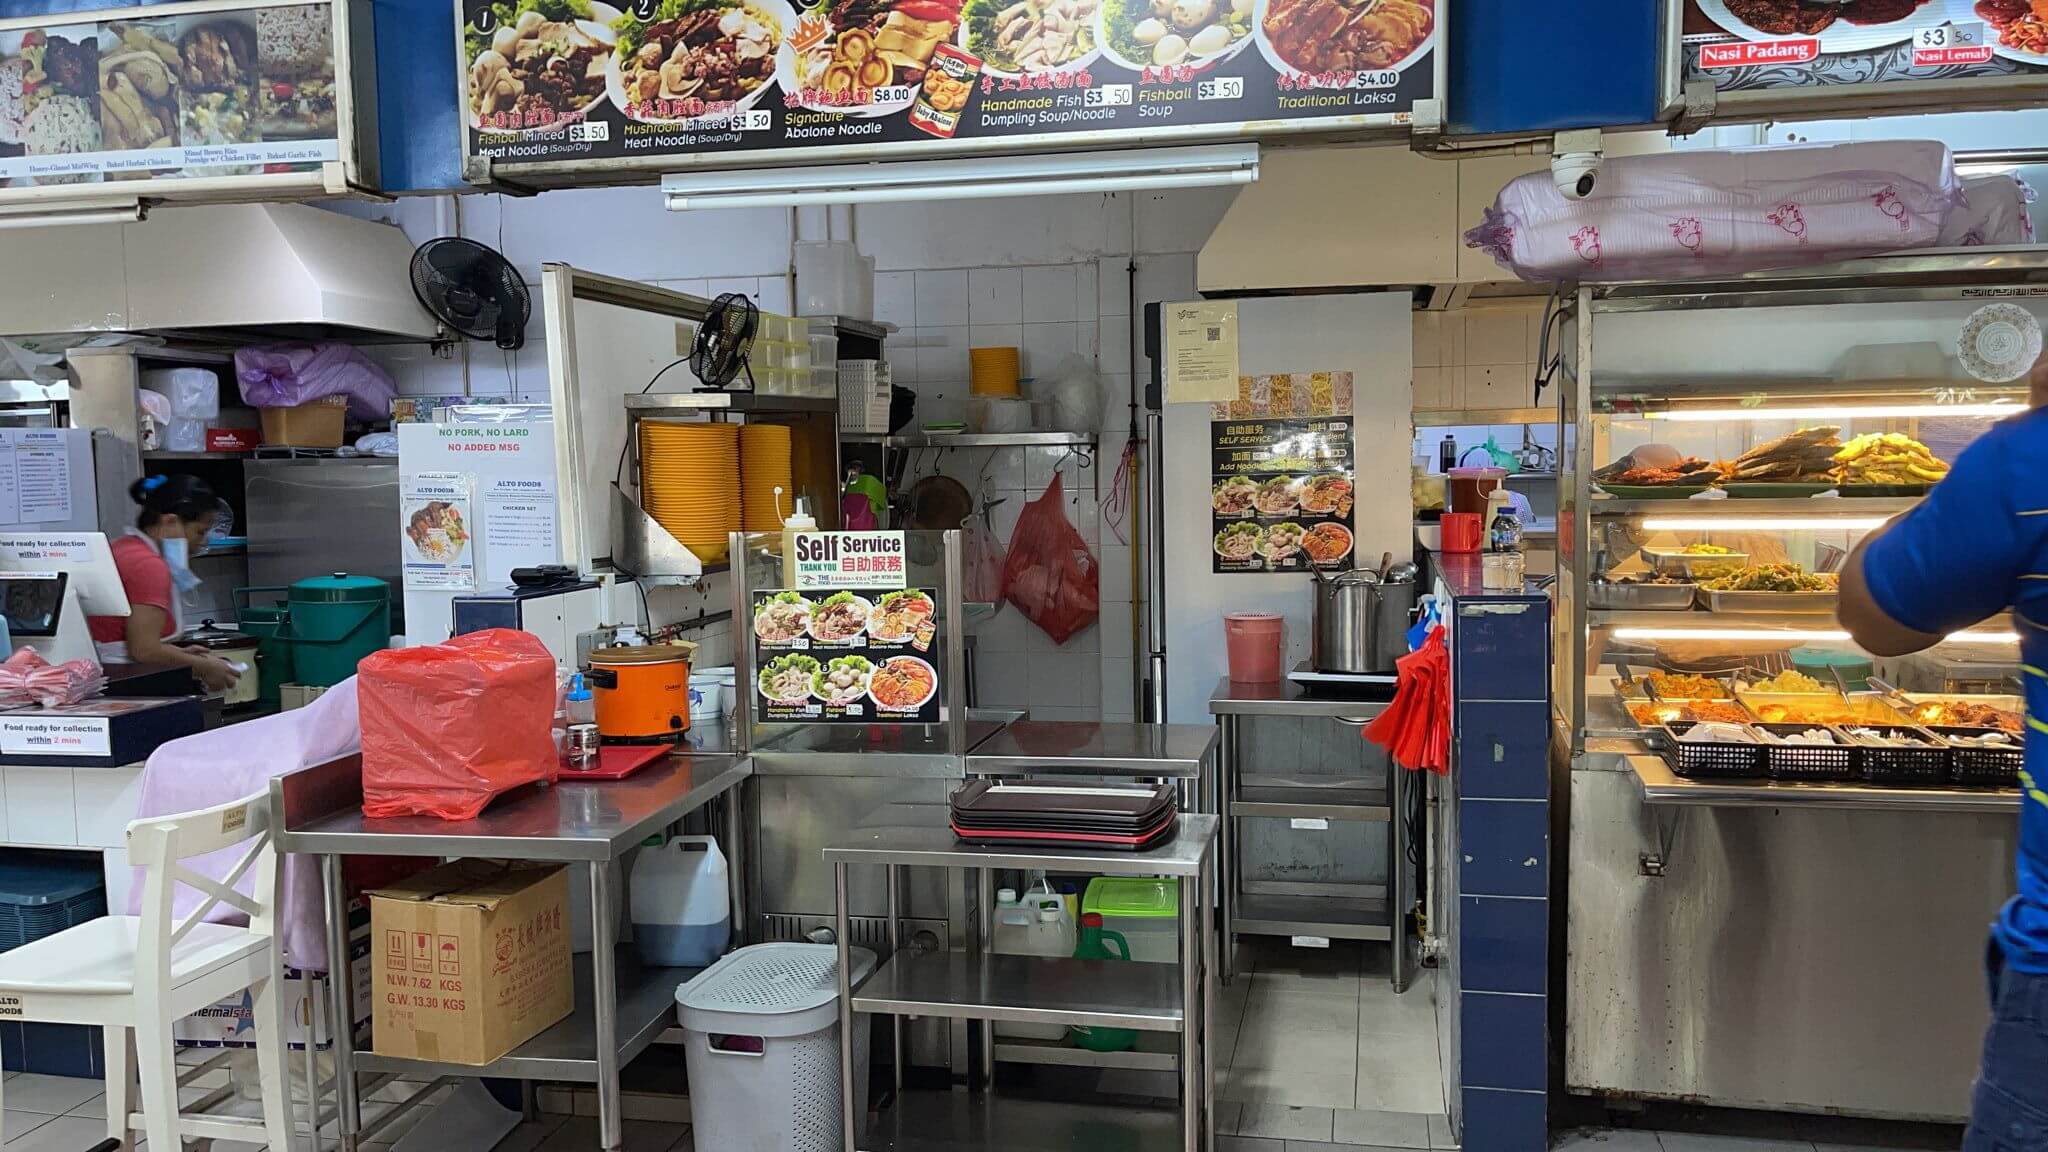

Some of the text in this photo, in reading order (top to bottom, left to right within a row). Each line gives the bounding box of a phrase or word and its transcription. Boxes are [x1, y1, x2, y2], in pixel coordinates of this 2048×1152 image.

[482, 11, 488, 27] 1
[1923, 26, 1945, 46] $3
[1704, 43, 1808, 60] Nasi Padang
[1915, 48, 1988, 61] Nasi Lemak
[1358, 73, 1396, 86] $4.00
[874, 88, 909, 102] $8.00
[1139, 81, 1240, 101] Fishball $3.50
[981, 88, 1129, 111] Handmade Fish $3.50
[1277, 92, 1396, 108] Traditional Laksa
[785, 111, 843, 125] Signature
[981, 108, 1116, 127] Dumpling Soup/Noodle
[1139, 104, 1173, 117] Soup
[624, 114, 769, 135] Mushroom Minced $3.50
[785, 123, 882, 139] Abalone Noodle
[479, 126, 606, 145] Fishball Minced $3.50
[624, 132, 742, 149] Meat Noodle (Soup/Dry)
[479, 143, 592, 158] Meat Noodle (Soup/Dry)
[439, 428, 529, 438] NO PORK, NO LARD
[1241, 435, 1272, 443] SERVICE
[448, 443, 520, 451] NO ADDED MSG
[796, 535, 900, 561] Self Service
[800, 563, 837, 571] THANK YOU
[842, 556, 902, 572] 自助服務
[25, 725, 47, 733] ready
[63, 724, 103, 732] collection
[386, 974, 462, 992] N.W. 7.62 KGS
[0, 997, 19, 1005] LTO
[387, 992, 465, 1011] G.W. 13.30 KGS
